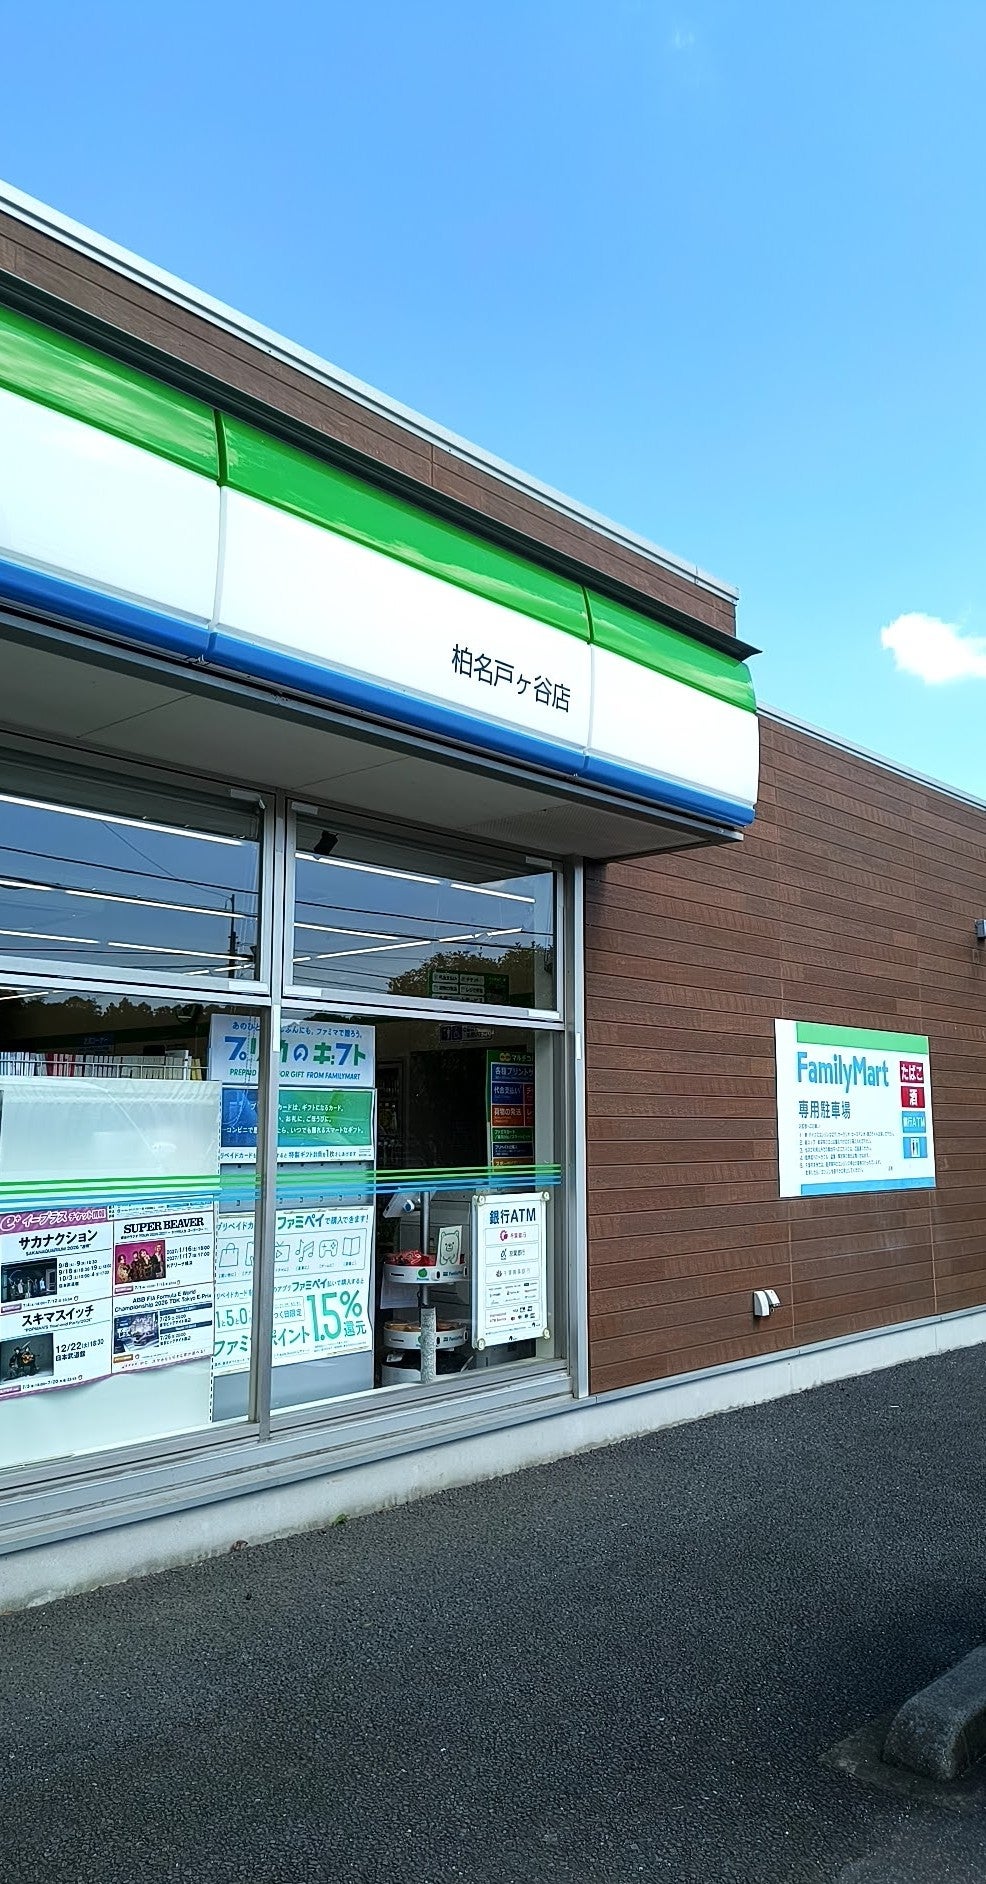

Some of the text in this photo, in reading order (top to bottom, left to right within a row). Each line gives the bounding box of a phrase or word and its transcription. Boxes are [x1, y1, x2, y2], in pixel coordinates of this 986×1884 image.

[451, 643, 570, 712] 柏名戸ヶ谷店
[229, 1068, 257, 1076] PREPAID
[291, 1071, 304, 1079] GIFT
[307, 1071, 324, 1079] FROM
[325, 1072, 361, 1080] FAMILYMART
[797, 1051, 889, 1093] FamilyMart
[901, 1063, 923, 1081] たばこ
[798, 1100, 851, 1119] 専用駐車場
[22, 1210, 68, 1227] イープラス
[68, 1209, 106, 1223] チケット情報
[489, 1207, 536, 1225] 銀行ATM
[123, 1221, 162, 1234] SUPER
[163, 1217, 205, 1230] BEAVER
[19, 1229, 98, 1250] サカナクション
[22, 1305, 95, 1327] スキマスイッチ
[115, 1302, 154, 1312] Championship
[343, 1320, 367, 1338] 還元
